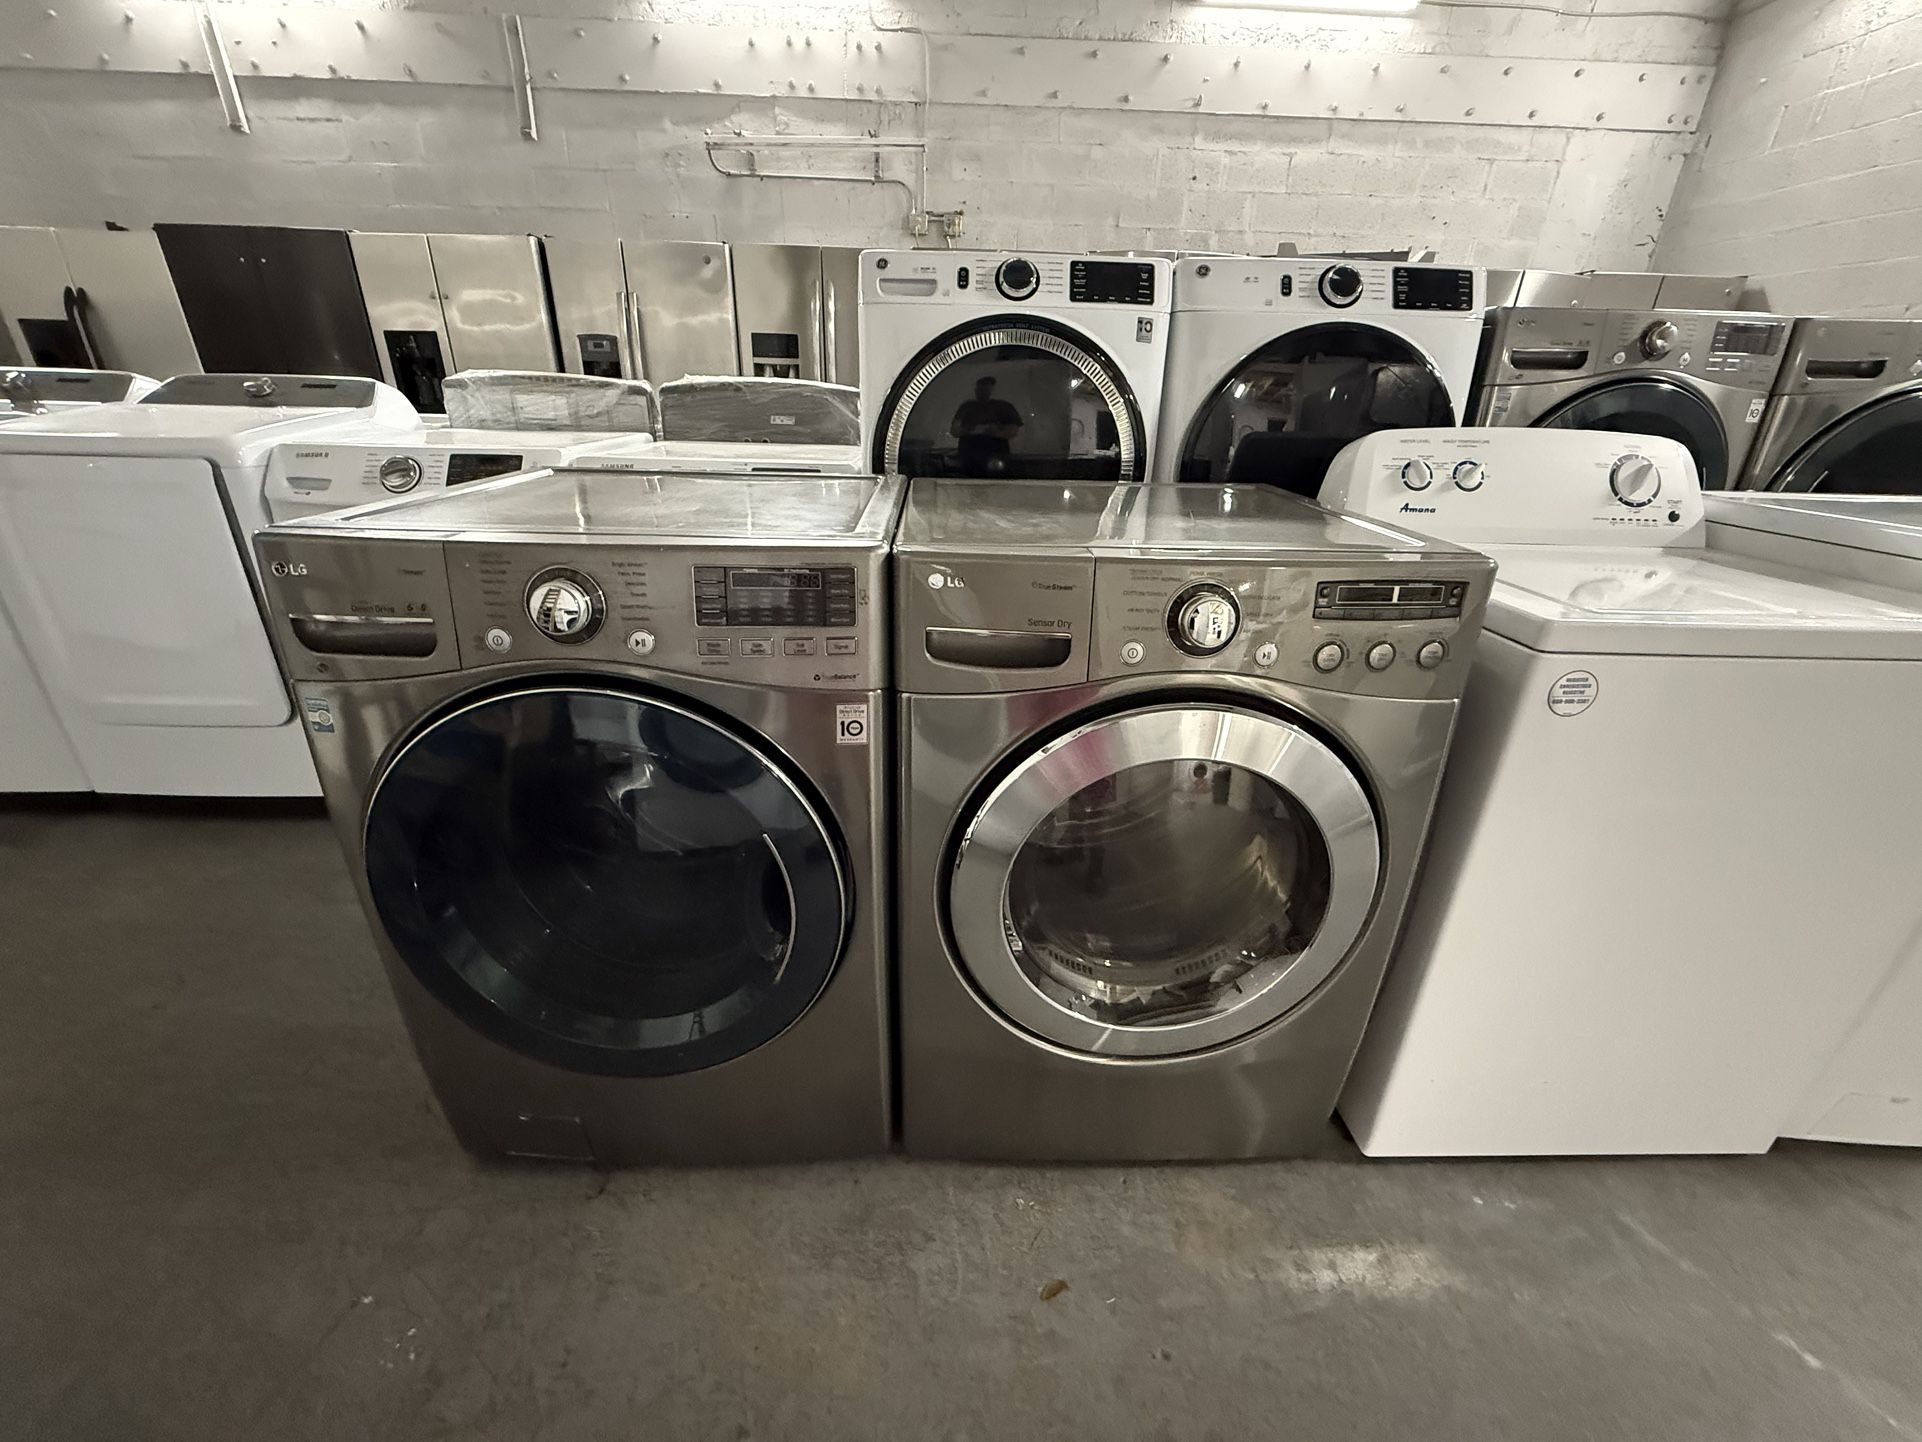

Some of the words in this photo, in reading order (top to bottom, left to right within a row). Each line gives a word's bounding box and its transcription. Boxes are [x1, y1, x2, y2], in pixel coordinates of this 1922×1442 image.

[1400, 503, 1436, 513] Amana
[290, 563, 308, 576] LG
[947, 576, 965, 588] LG
[1028, 618, 1055, 627] Sensor
[1057, 619, 1072, 629] Dry
[840, 720, 864, 737] 10
